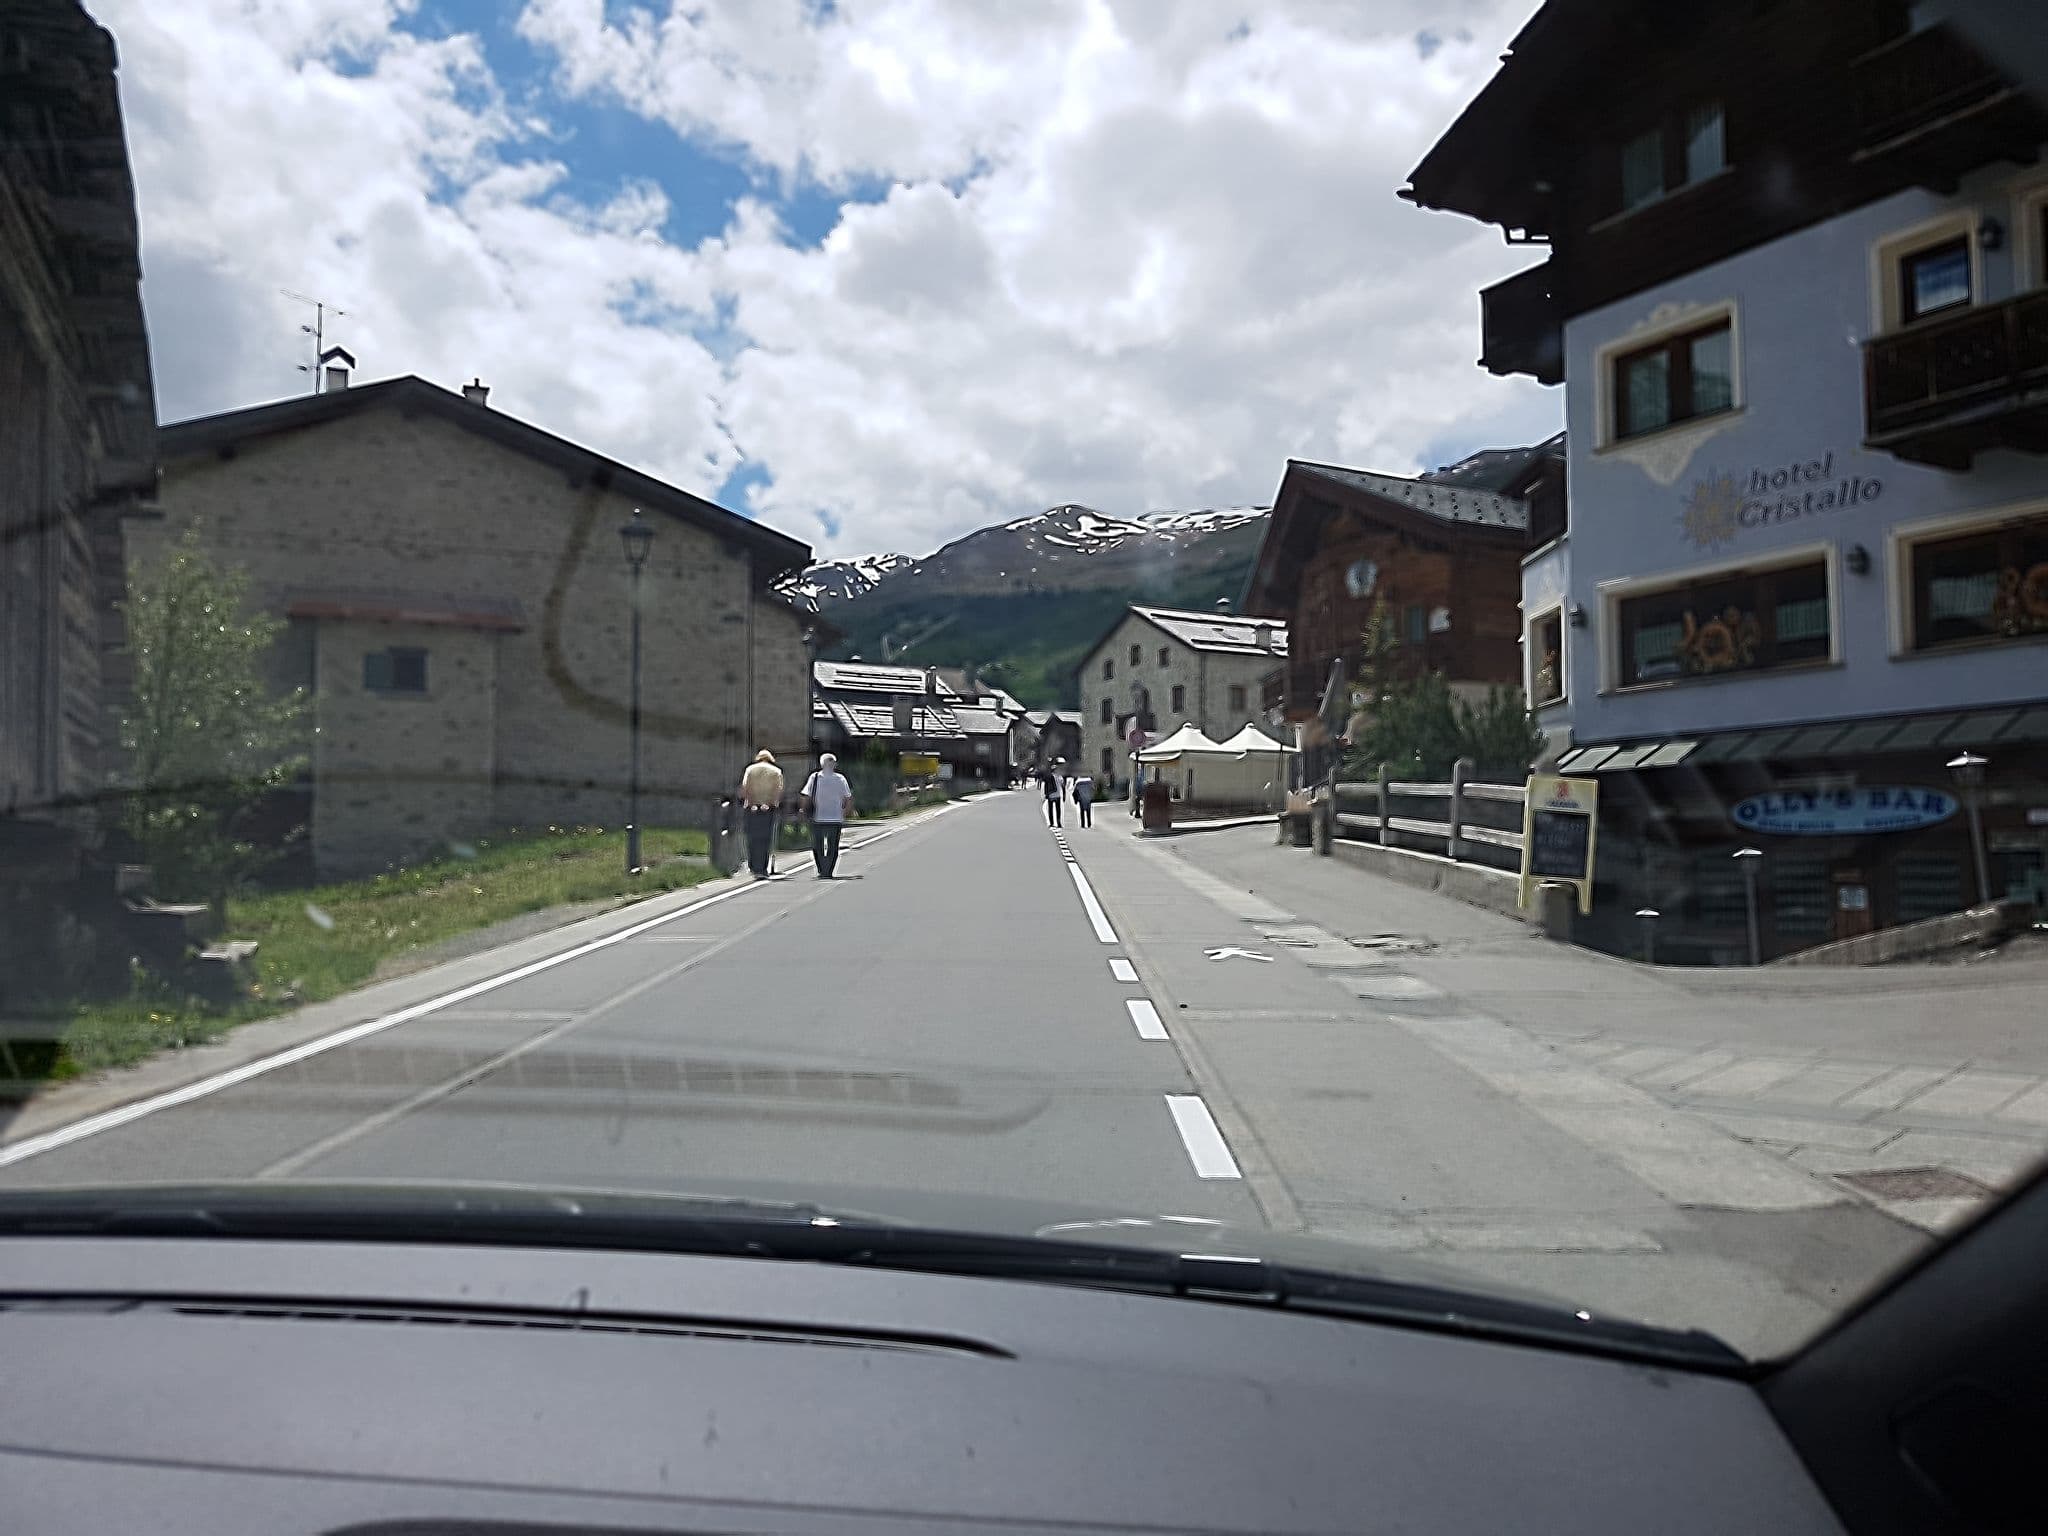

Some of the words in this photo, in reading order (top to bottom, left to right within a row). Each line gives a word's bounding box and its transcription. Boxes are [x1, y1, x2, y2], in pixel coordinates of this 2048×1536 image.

[1751, 449, 1833, 491] hotel
[1738, 478, 1882, 527] Cristallo
[1738, 791, 1851, 821] OLLY'S
[1870, 790, 1946, 815] BAR
